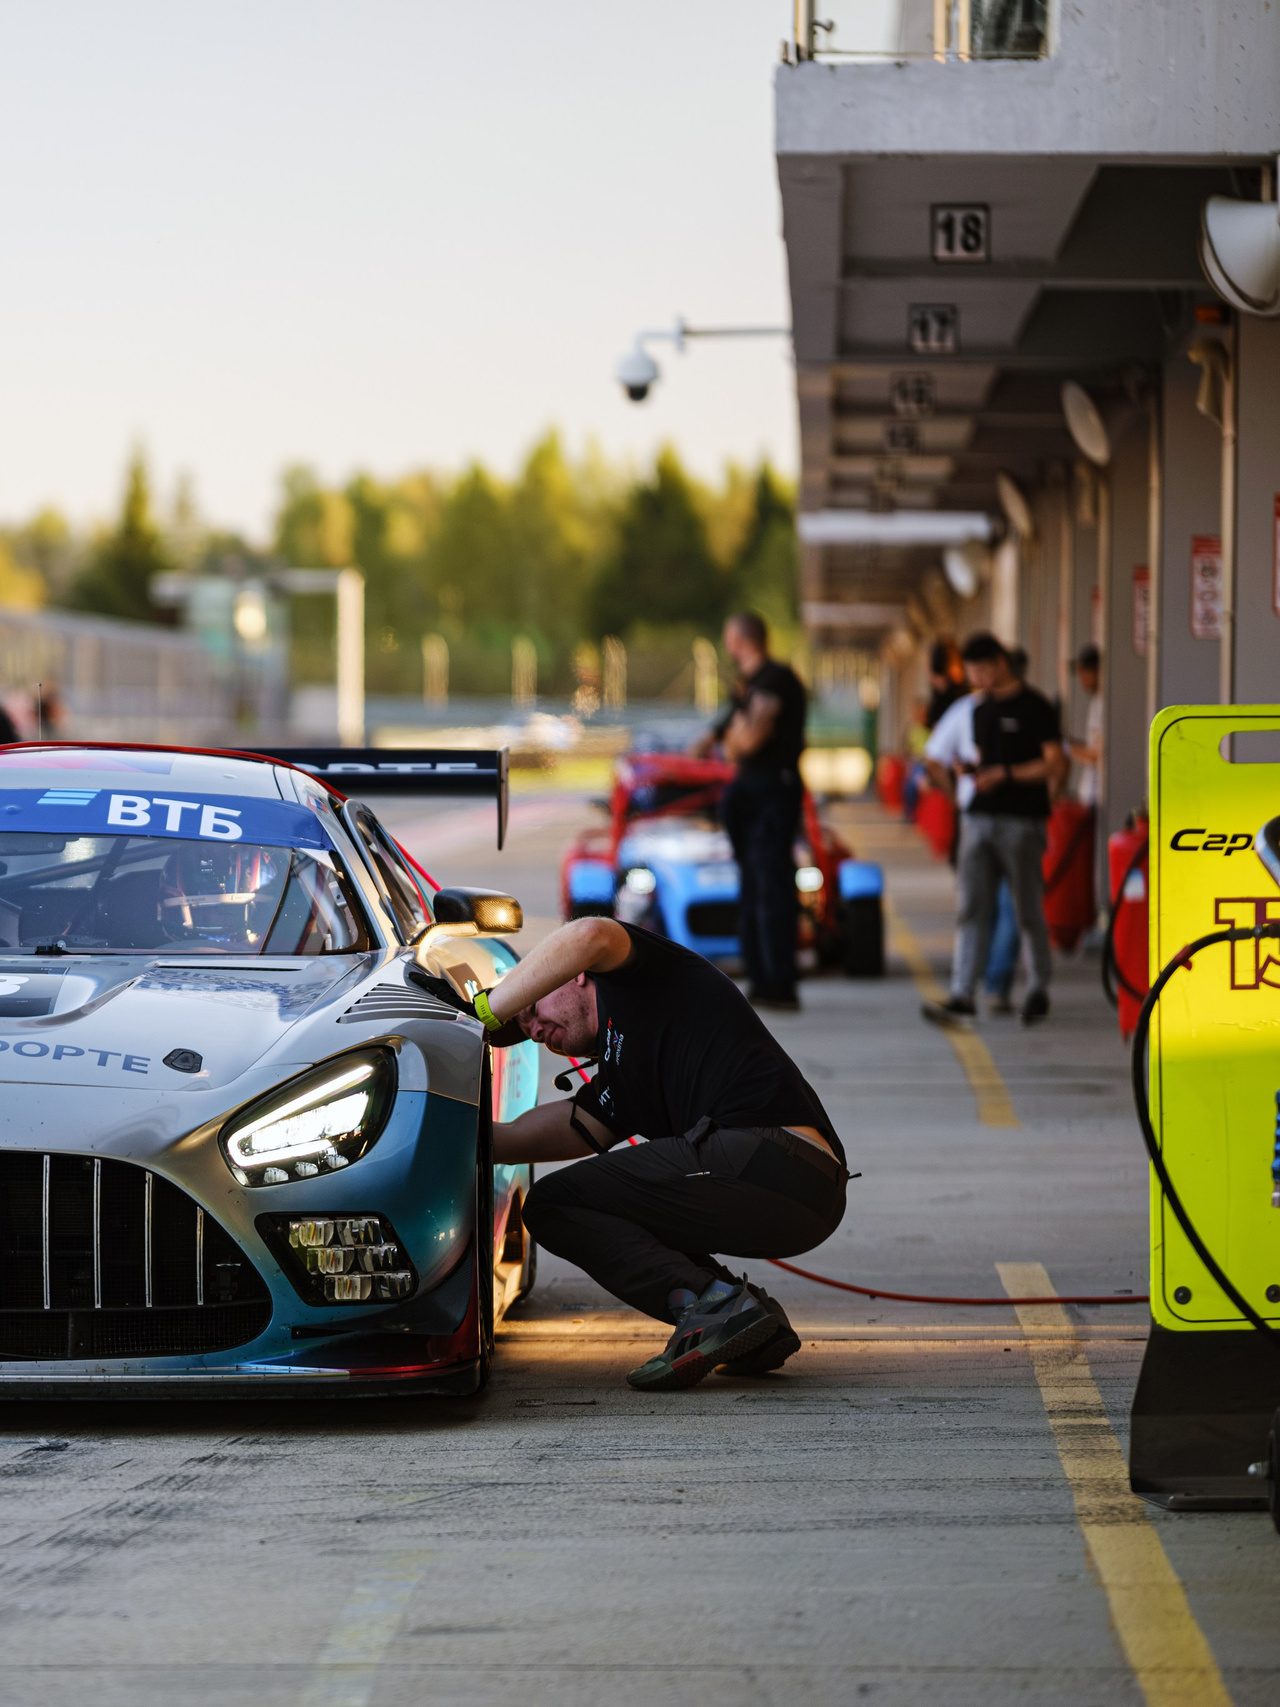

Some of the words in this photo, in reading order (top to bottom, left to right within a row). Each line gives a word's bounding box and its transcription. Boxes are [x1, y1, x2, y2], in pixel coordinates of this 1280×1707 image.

[937, 212, 983, 255] 18
[107, 794, 243, 840] ВТБ
[1170, 828, 1256, 856] Cap
